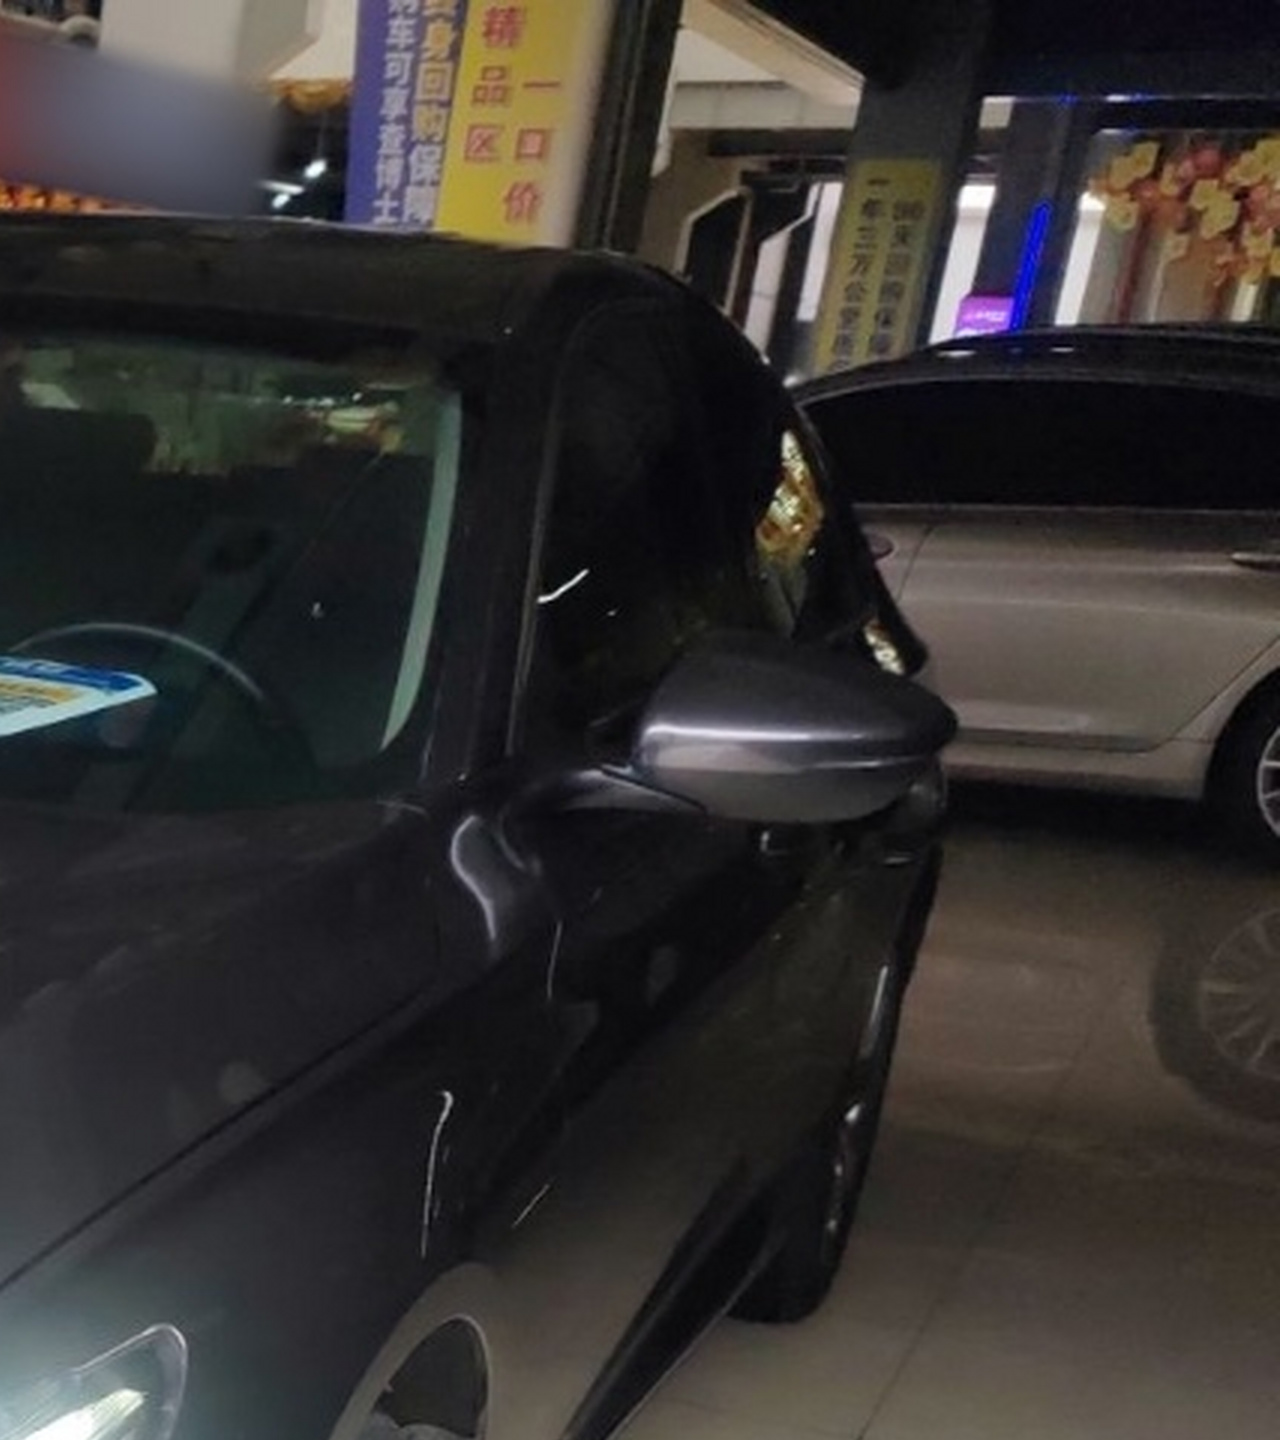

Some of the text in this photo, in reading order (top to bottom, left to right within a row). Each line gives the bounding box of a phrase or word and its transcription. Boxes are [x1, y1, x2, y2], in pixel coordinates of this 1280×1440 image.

[464, 6, 526, 162] 精品区
[504, 80, 561, 223] 一口价
